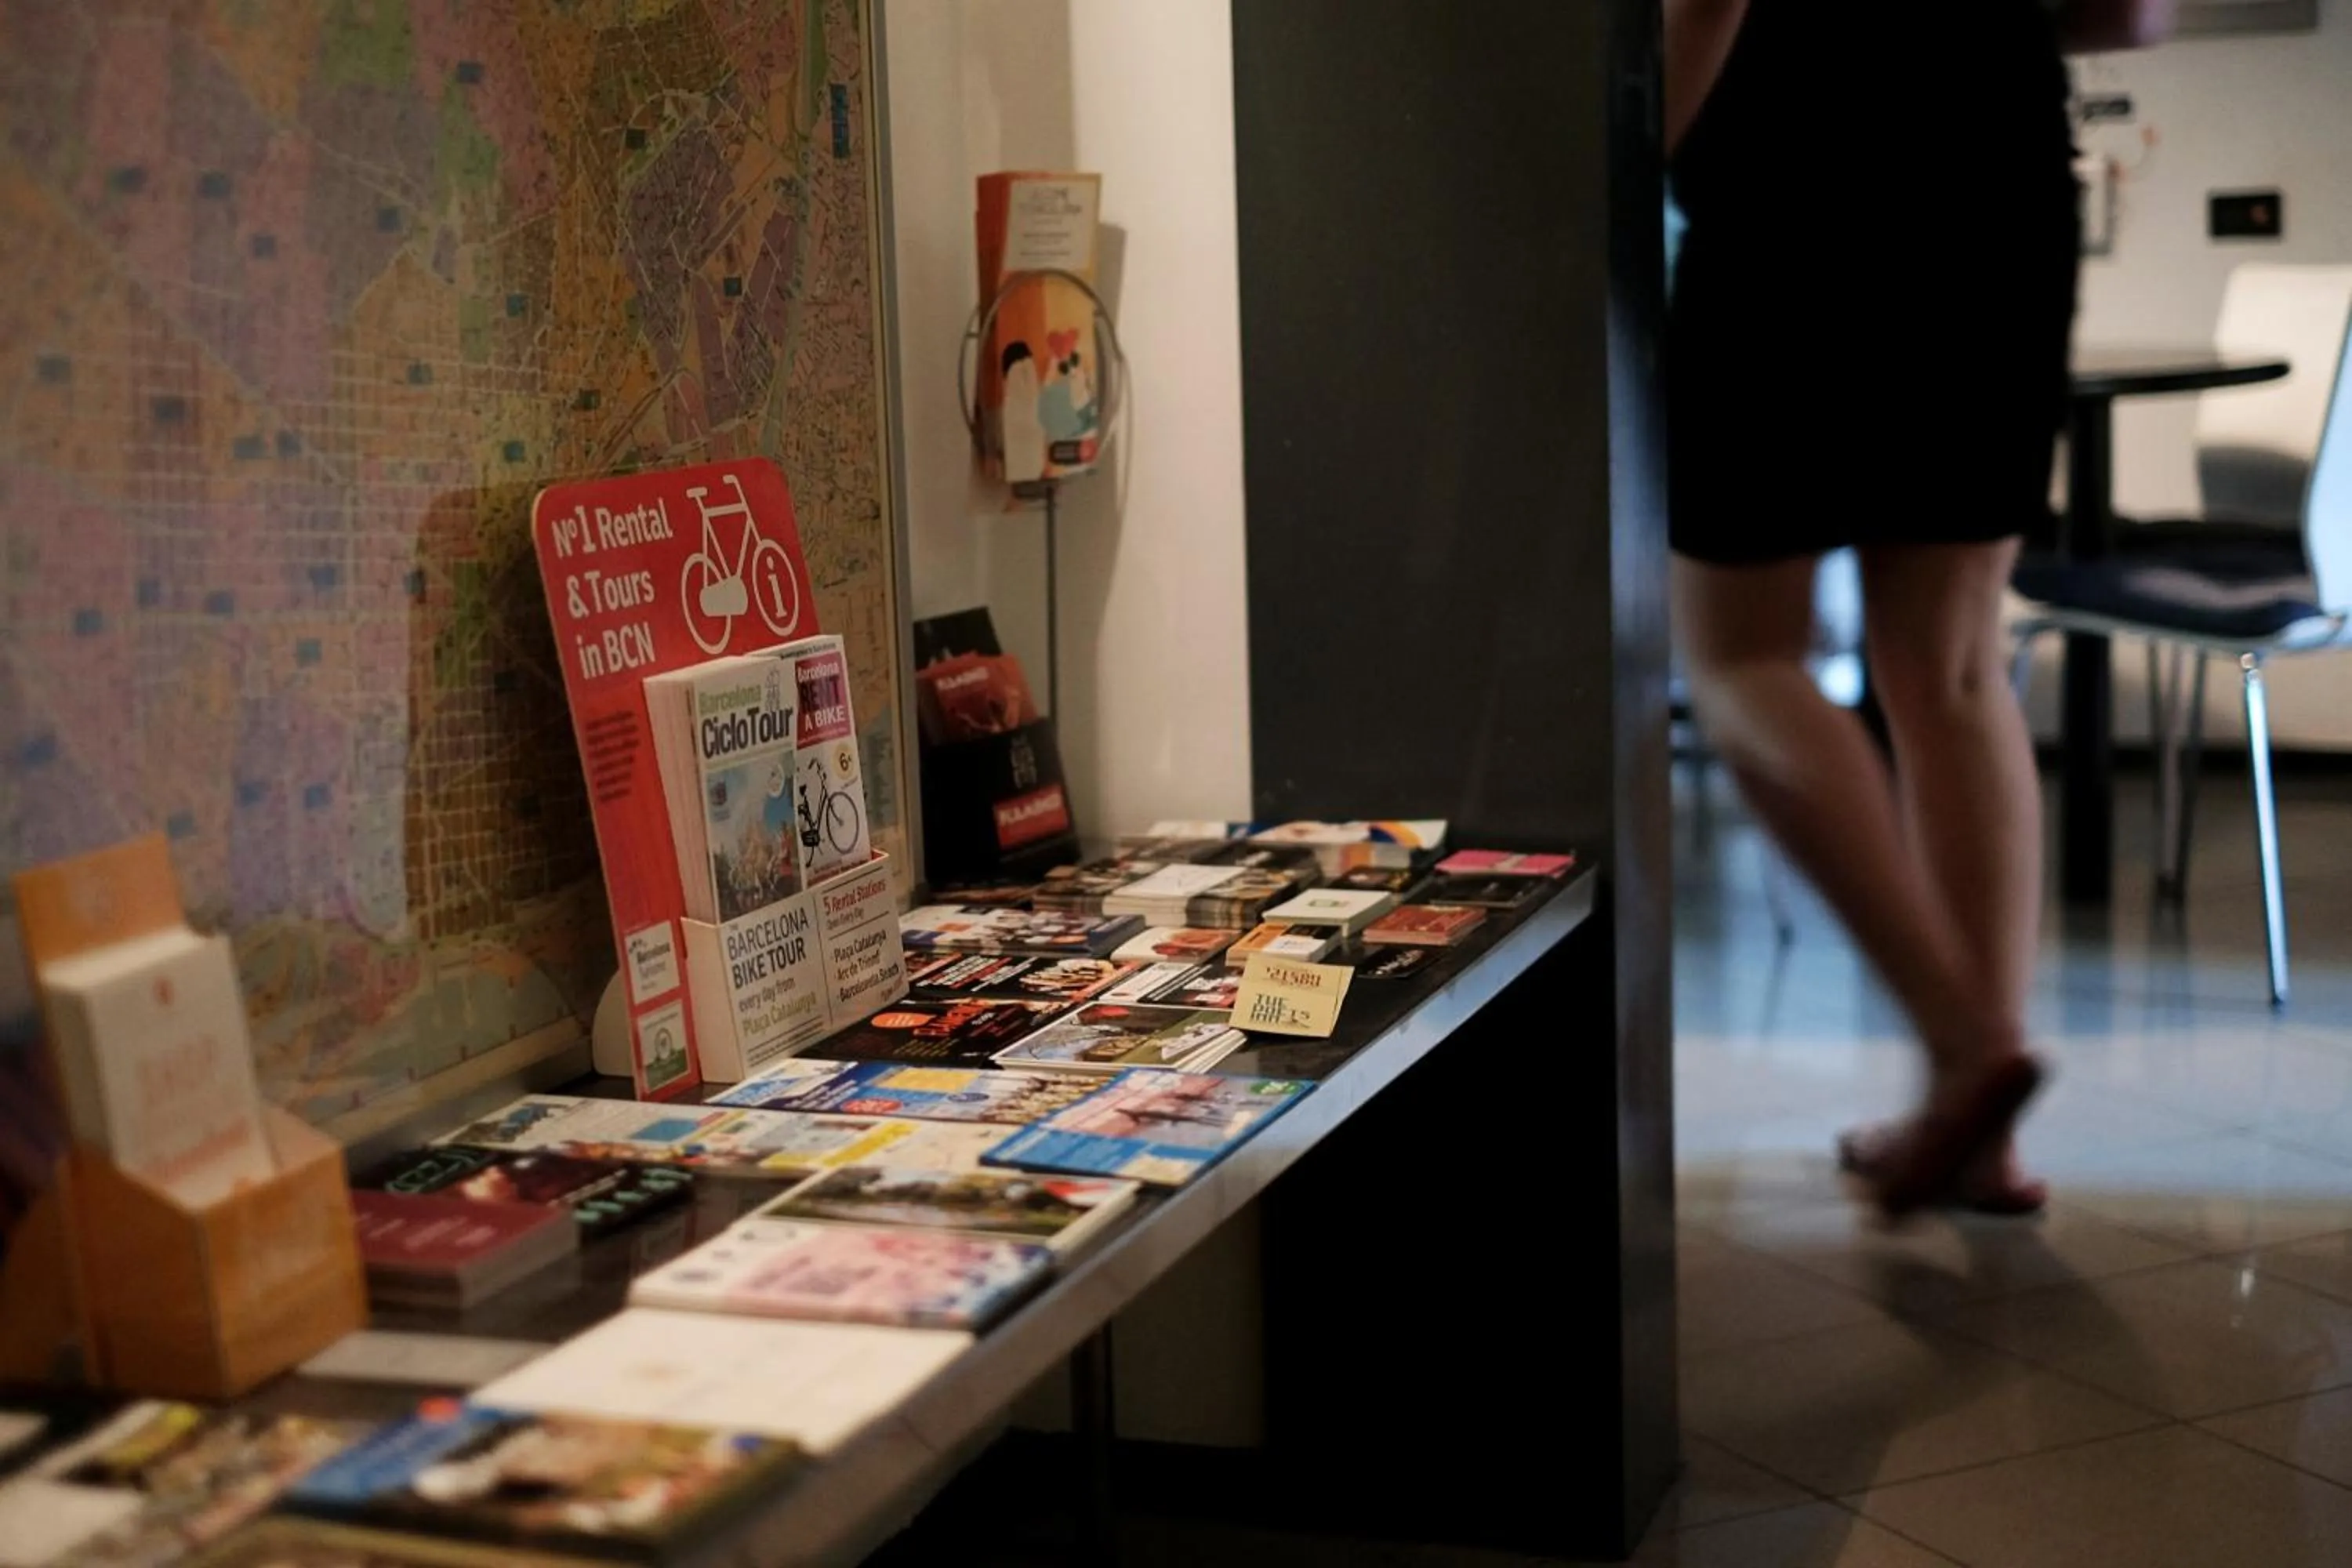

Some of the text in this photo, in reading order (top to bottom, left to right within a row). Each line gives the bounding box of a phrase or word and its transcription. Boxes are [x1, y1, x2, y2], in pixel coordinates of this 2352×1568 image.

[595, 497, 673, 550] Rental
[566, 570, 655, 619] & Tours
[575, 622, 655, 681] in BCN
[702, 706, 793, 760] CicloTour
[804, 706, 846, 731] A BIKE
[823, 896, 831, 916] 5
[727, 907, 809, 961] BARCELONA
[732, 937, 807, 990] BIKE TOUR
[739, 992, 761, 1013] every
[762, 985, 776, 1002] day
